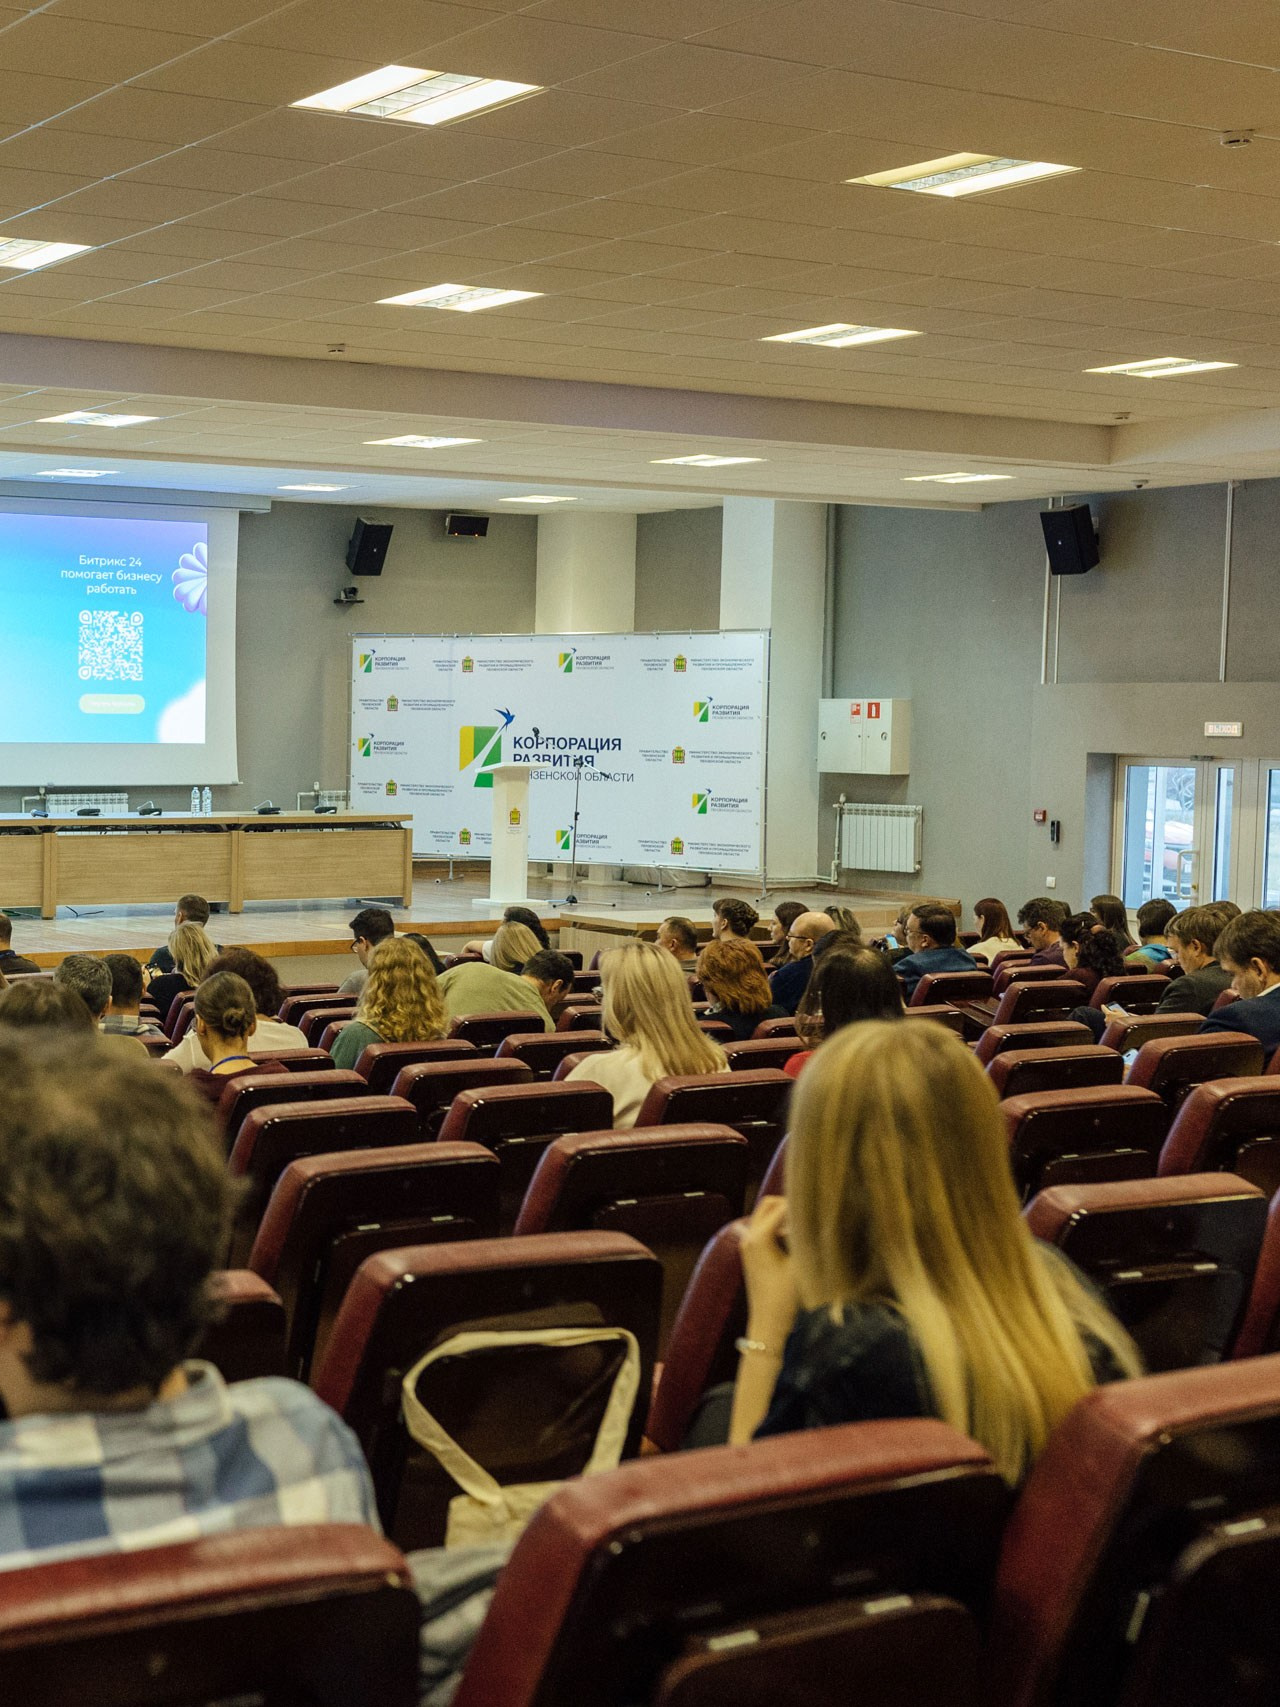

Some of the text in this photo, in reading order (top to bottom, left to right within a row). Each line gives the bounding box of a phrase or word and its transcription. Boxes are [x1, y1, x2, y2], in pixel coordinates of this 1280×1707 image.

[79, 555, 142, 567] Битрикс 24
[61, 570, 162, 584] помогает бизнесу
[87, 584, 137, 595] работать
[1208, 725, 1238, 734] ВЫХОД
[514, 737, 622, 753] КОРПОРАЦИЯ
